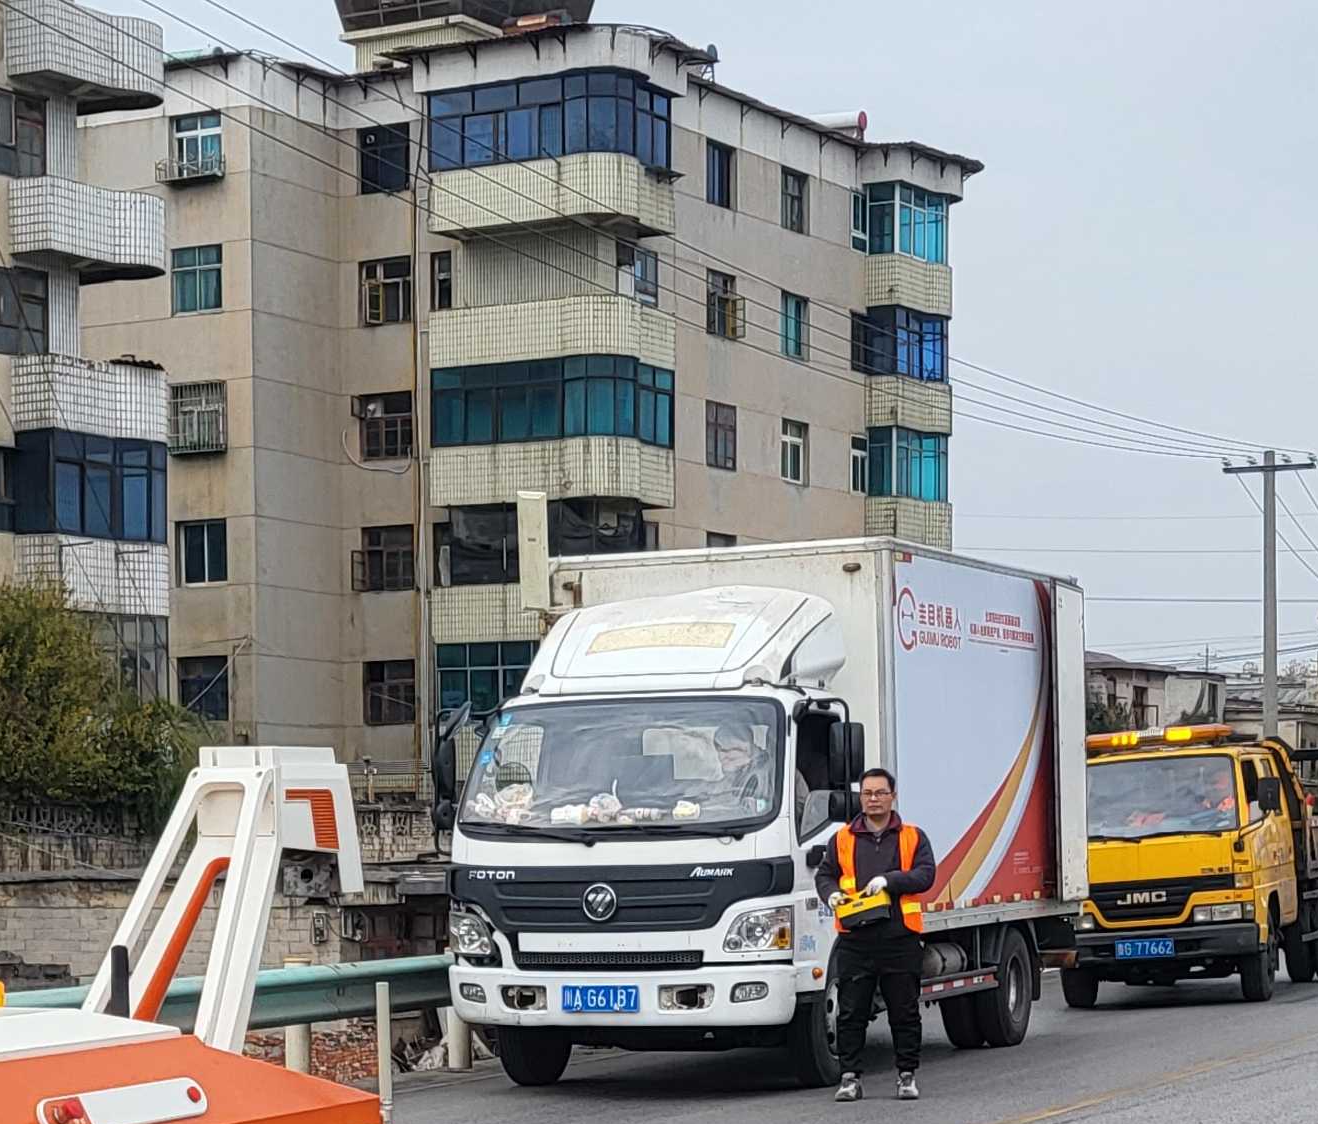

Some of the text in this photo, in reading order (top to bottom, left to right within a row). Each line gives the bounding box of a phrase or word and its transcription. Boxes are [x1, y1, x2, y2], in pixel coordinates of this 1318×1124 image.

[940, 633, 962, 650] ROBOT
[468, 870, 516, 880] FOTON
[1116, 890, 1167, 905] JMC
